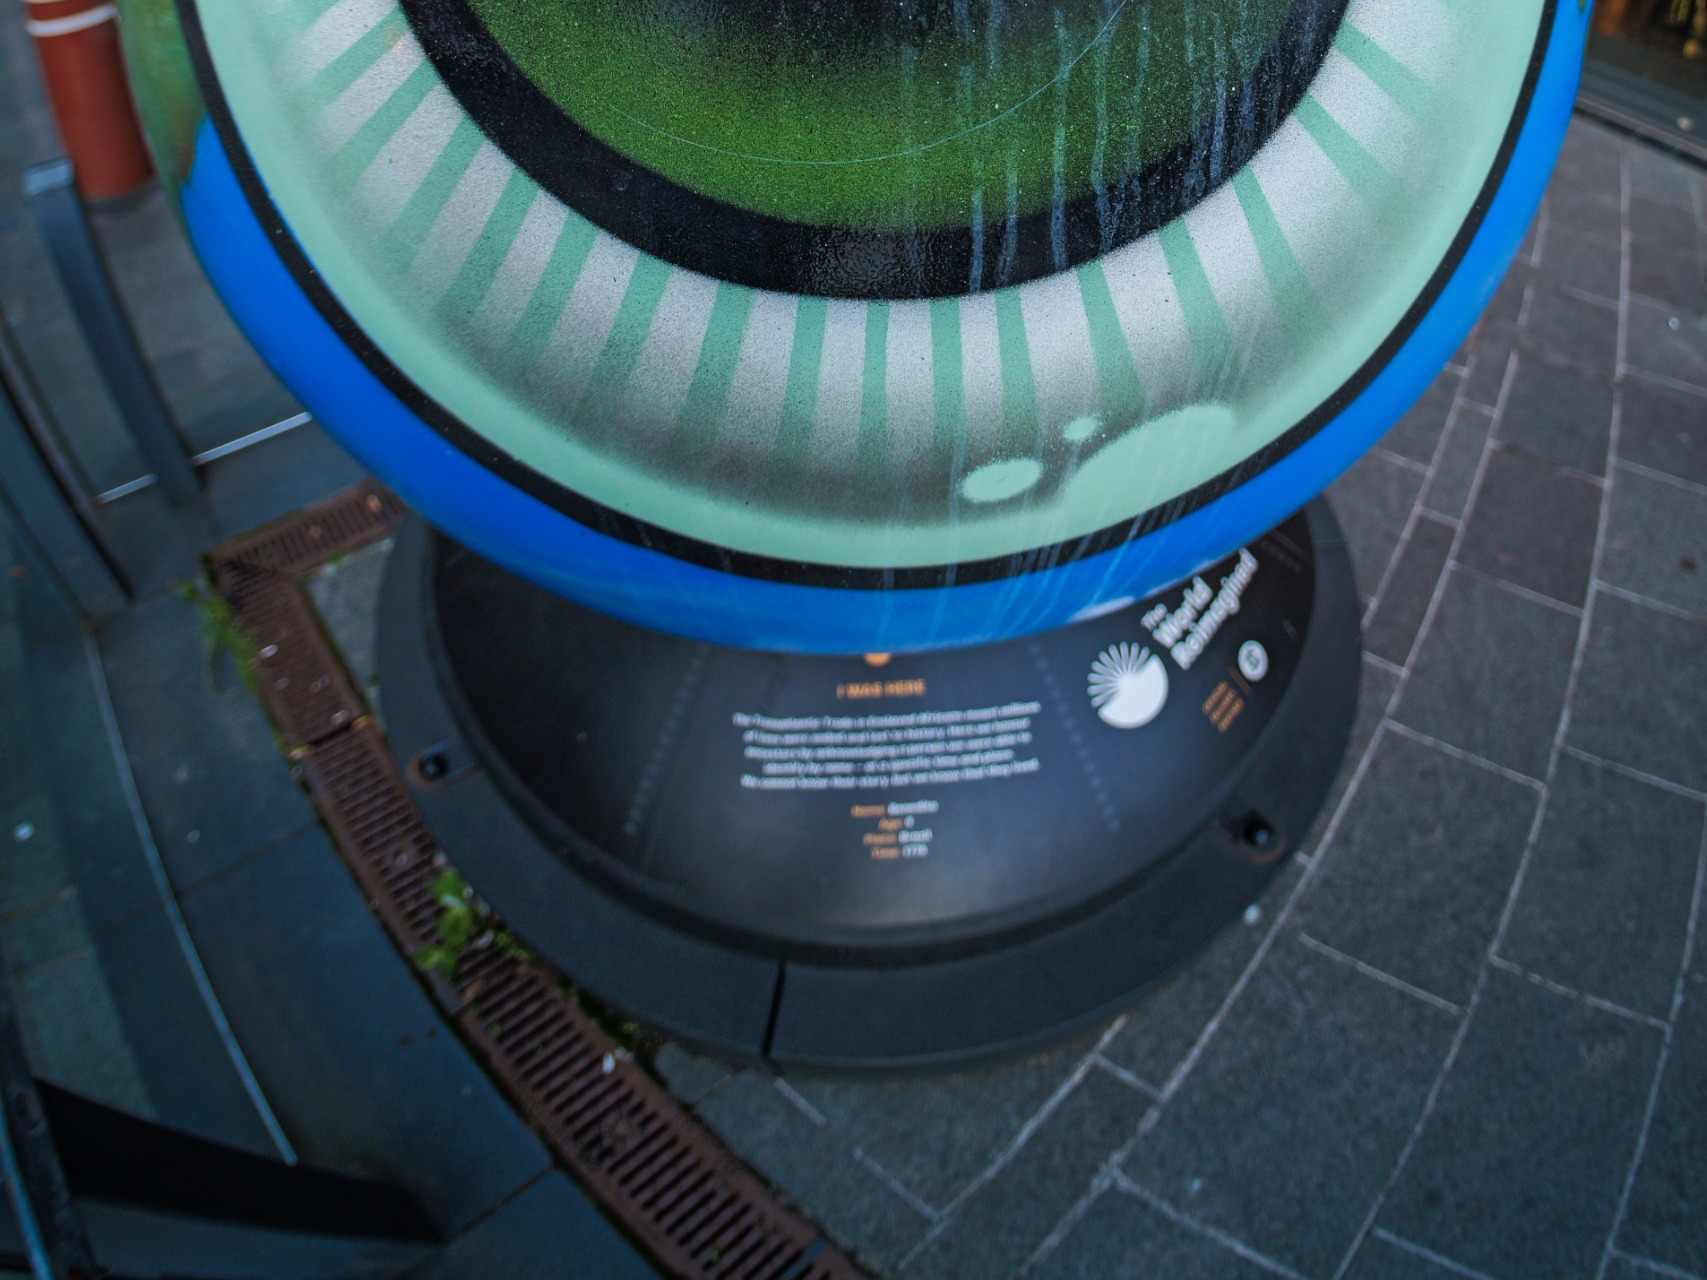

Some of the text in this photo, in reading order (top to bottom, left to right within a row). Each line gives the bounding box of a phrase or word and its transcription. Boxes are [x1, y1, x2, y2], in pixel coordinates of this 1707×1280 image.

[1141, 603, 1168, 630] The
[1152, 575, 1213, 649] World
[1170, 547, 1258, 670] Reimagined
